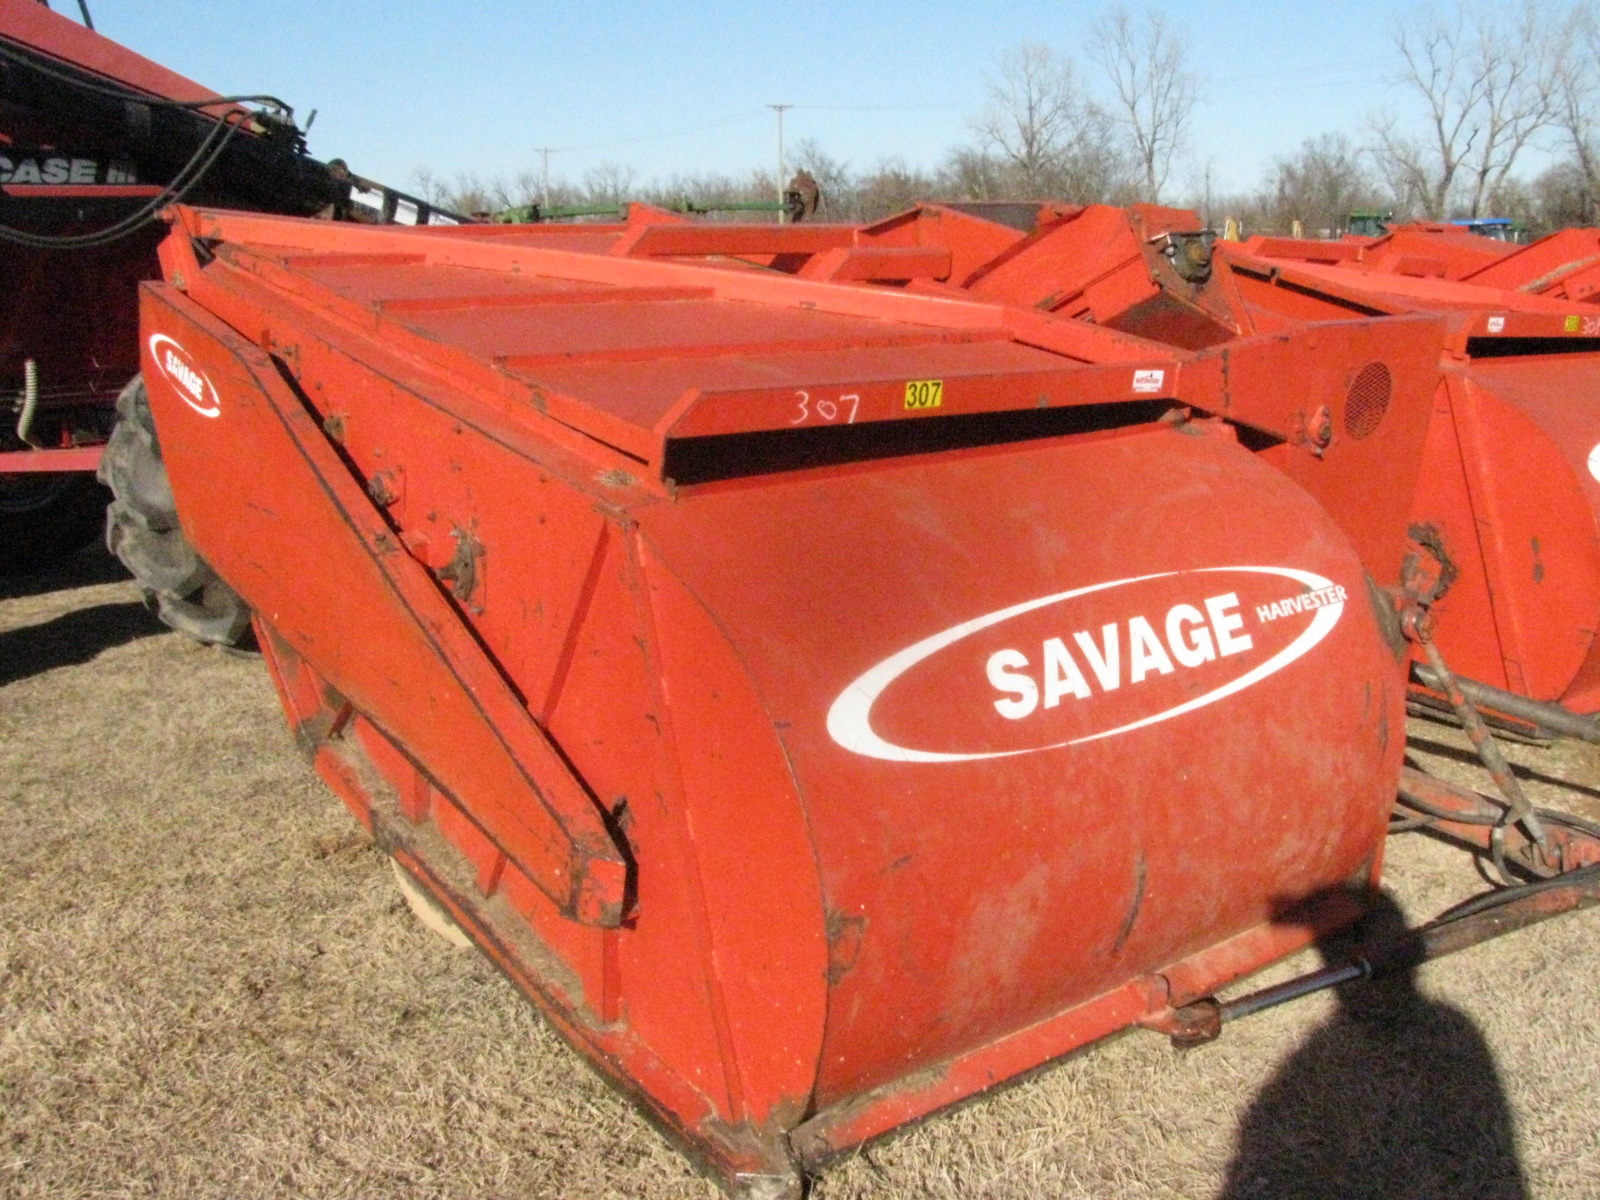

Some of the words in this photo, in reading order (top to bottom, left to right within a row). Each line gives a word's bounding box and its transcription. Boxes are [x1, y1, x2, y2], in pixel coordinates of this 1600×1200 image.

[0, 157, 98, 184] CASE
[166, 350, 203, 402] SAVAGE
[790, 390, 860, 425] 307
[906, 382, 941, 407] 307
[986, 592, 1254, 720] SAVAGE
[1256, 585, 1348, 623] HARVESTER
